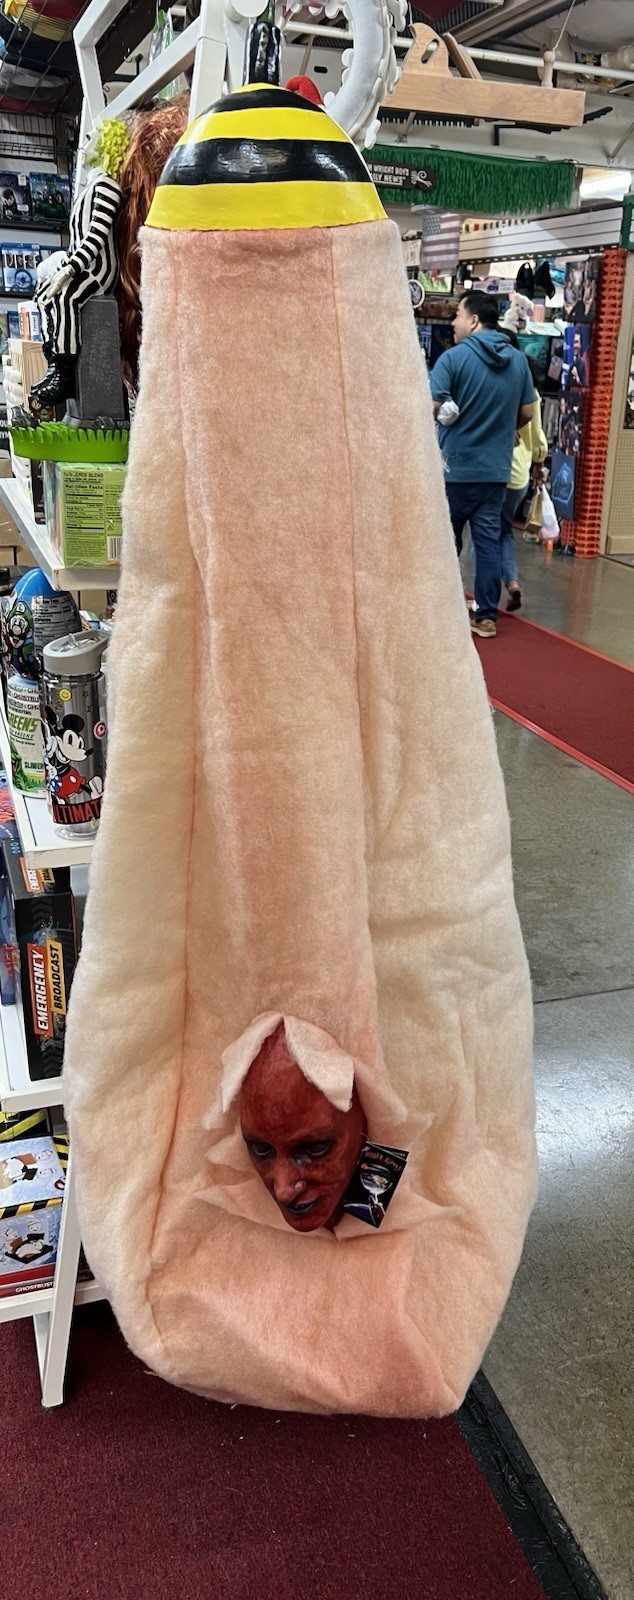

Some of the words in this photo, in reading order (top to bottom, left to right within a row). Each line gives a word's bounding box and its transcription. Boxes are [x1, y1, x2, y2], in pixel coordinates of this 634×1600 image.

[373, 165, 394, 174] WRIGHT
[395, 167, 409, 176] BOYS
[32, 949, 49, 1031] EMERGENCY
[50, 944, 63, 1010] BROADCAST
